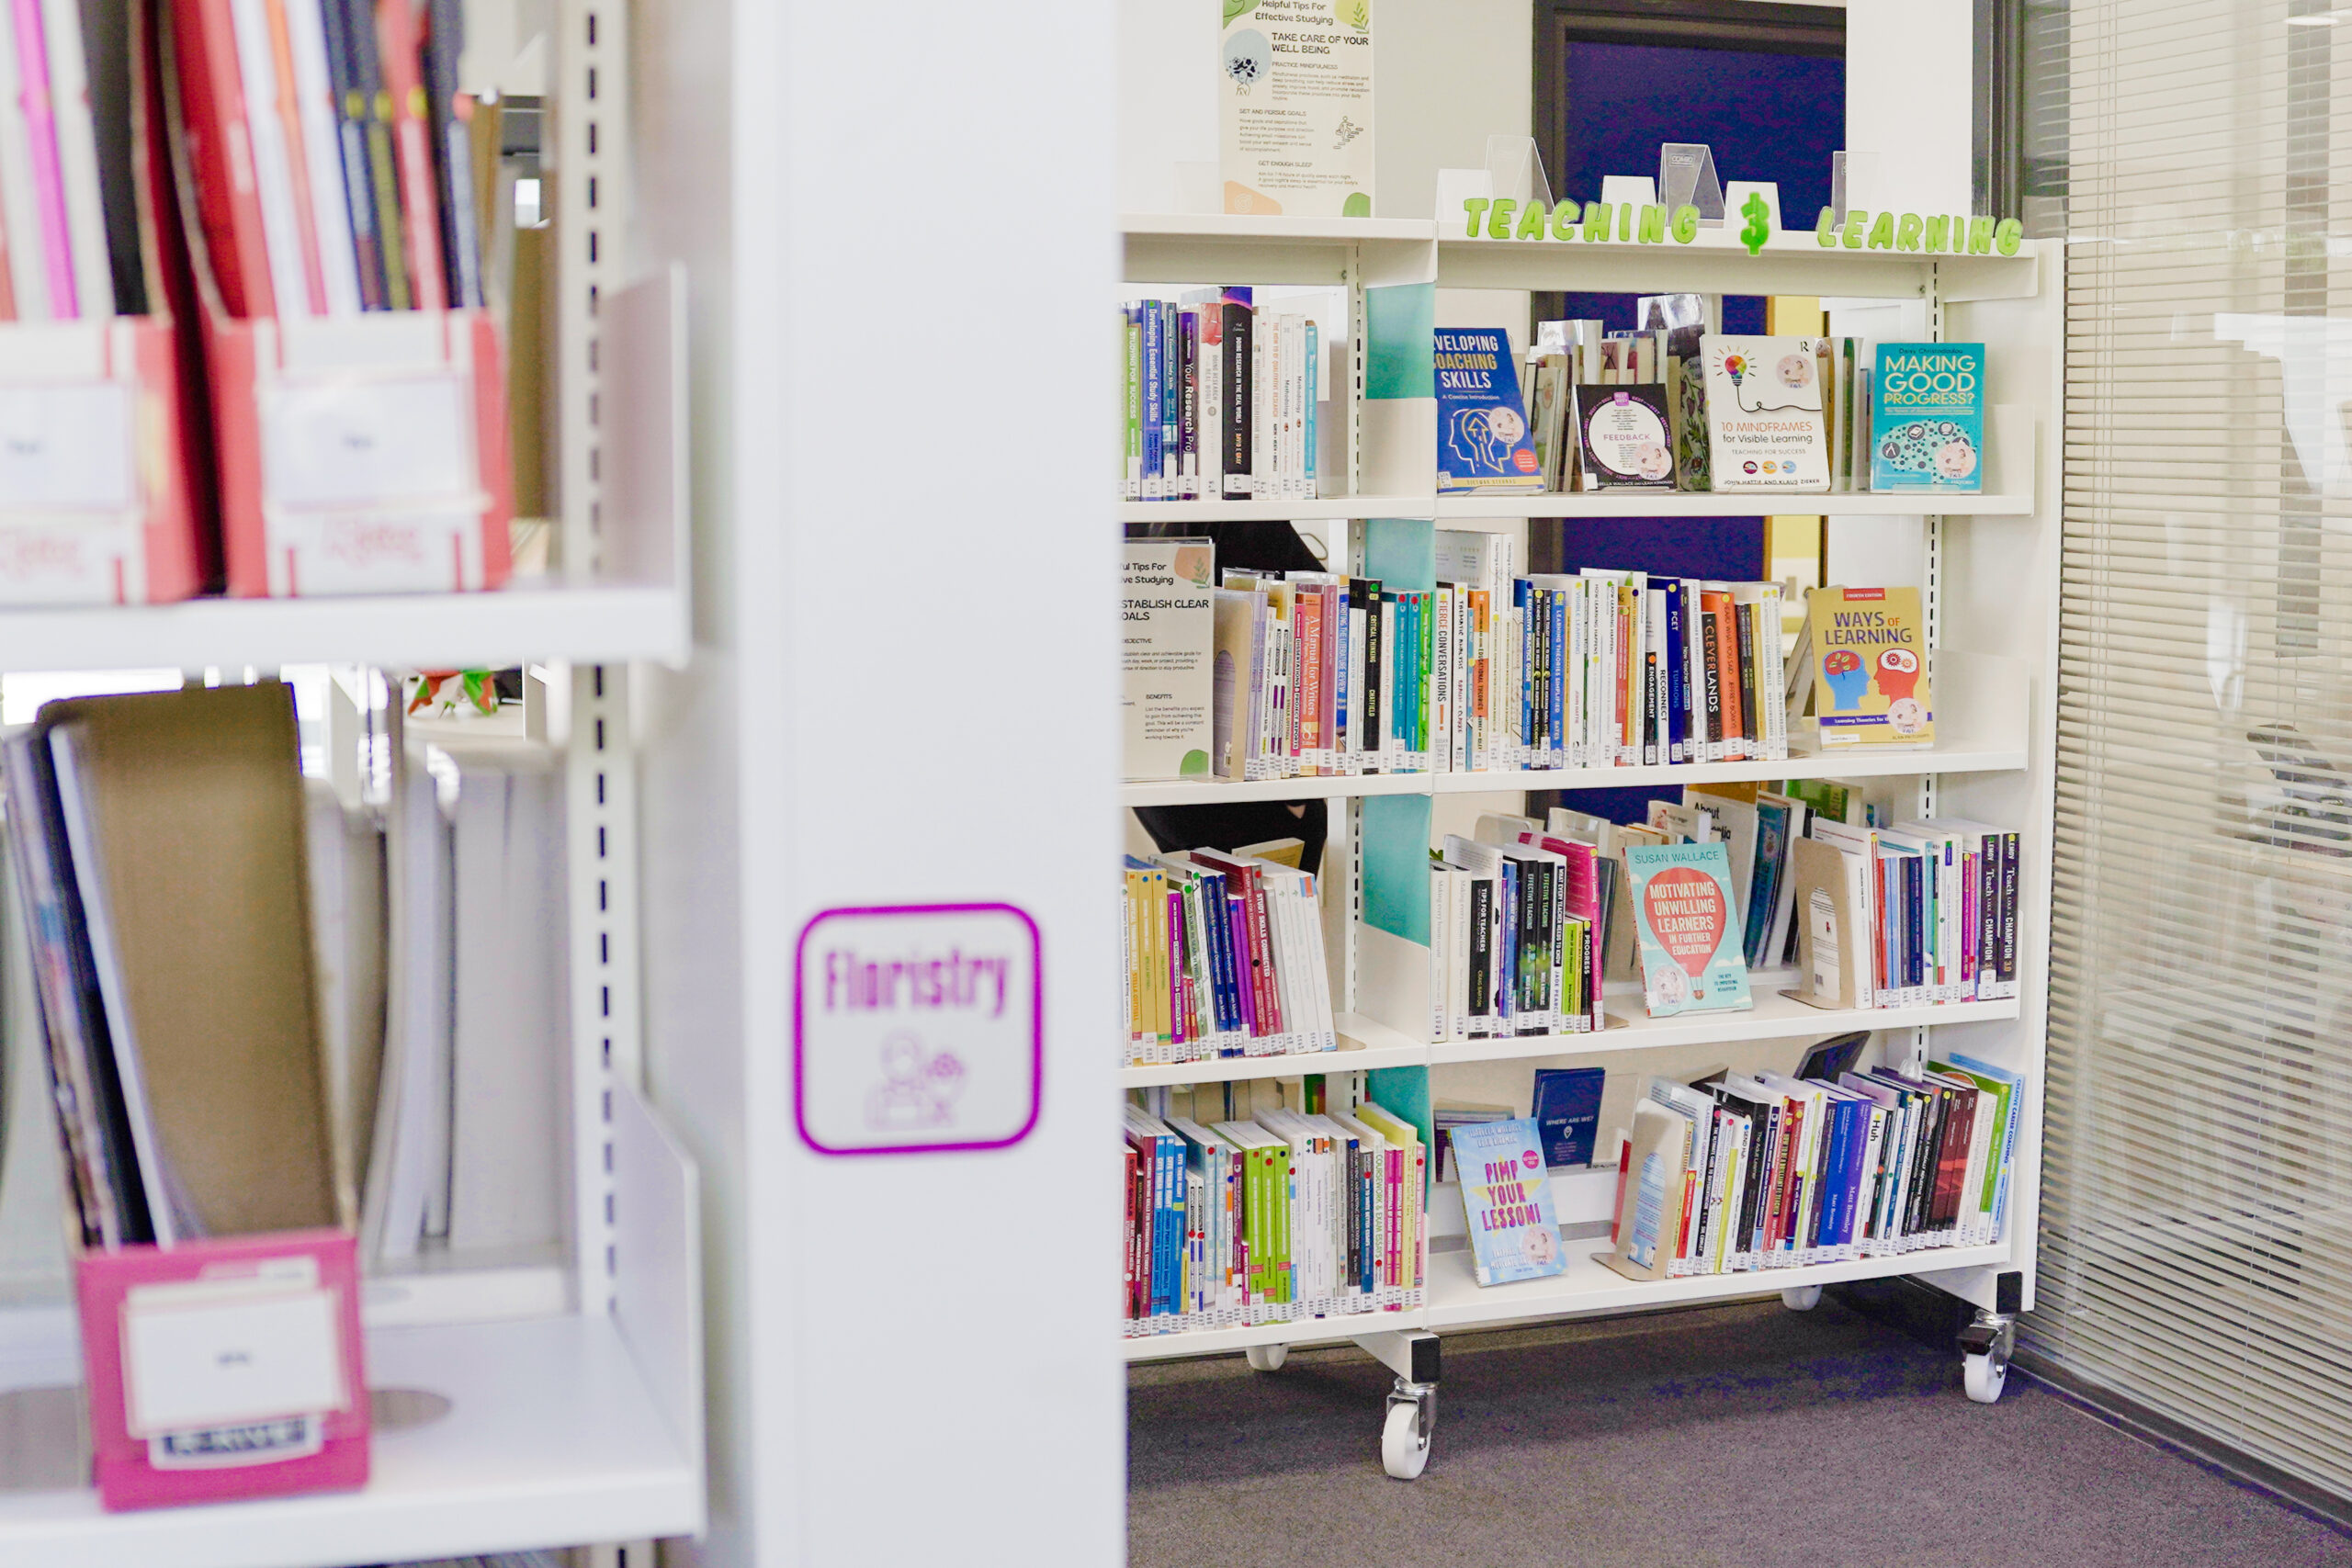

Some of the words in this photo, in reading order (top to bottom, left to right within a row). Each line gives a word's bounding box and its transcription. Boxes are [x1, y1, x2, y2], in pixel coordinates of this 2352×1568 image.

[1261, 0, 1291, 9] Helpful
[1293, 1, 1310, 11] Tips
[1311, 2, 1327, 10] For
[1255, 12, 1295, 22] Effective
[1295, 14, 1334, 26] Studying
[1272, 32, 1298, 42] TAKE
[1300, 34, 1326, 43] CARE
[1328, 35, 1341, 44] OF
[1343, 37, 1369, 45] YOUR
[1272, 43, 1299, 53] WELL
[1301, 45, 1330, 54] BEING
[1464, 197, 1699, 244] TEACHING
[1816, 206, 2024, 257] LEARNING
[1147, 309, 1158, 347] Developing
[1434, 334, 1499, 352] VELOPING
[1800, 341, 1809, 352] R
[1148, 348, 1158, 379] Essential
[1433, 353, 1498, 370] OACHING
[1884, 355, 1976, 372] MAKING
[1441, 371, 1492, 389] SKILLS
[1884, 372, 1975, 392] GOOD
[1148, 381, 1158, 400] Study
[1883, 392, 1975, 405] PROGRESS?
[1148, 401, 1159, 422] Skills
[1721, 422, 1734, 433] 10
[1736, 421, 1813, 433] MINDFRAMES
[1723, 434, 1736, 444] for
[1737, 434, 1769, 444] Visible
[1771, 434, 1814, 445] Learning
[1132, 563, 1149, 572] Tips
[1151, 562, 1167, 570] For
[1135, 576, 1174, 585] Studying
[1120, 599, 1172, 609] STABLISH
[1174, 599, 1209, 609] CLEAR
[1121, 611, 1150, 621] OALS
[1310, 615, 1320, 624] A
[1340, 602, 1348, 626] WRITING
[1438, 600, 1448, 630] FIERCE
[1834, 611, 1884, 627] WAYS
[1887, 617, 1901, 626] OF
[1308, 626, 1320, 665] Manual
[1825, 627, 1913, 646] LEARNING
[1339, 637, 1347, 670] LITERATURE
[1308, 666, 1319, 680] for
[1438, 630, 1448, 702] CONVERSATIONS
[1704, 626, 1719, 713] CLEVERLANDS
[1338, 671, 1346, 694] REVIEW
[1307, 681, 1318, 716] Writers
[1634, 853, 1669, 864] SUSAN
[1672, 851, 1720, 862] WALLACE
[1649, 881, 1716, 899] MOTIVATING
[1256, 893, 1265, 914] STUDY
[1654, 897, 1716, 917] UNWILLING
[1258, 915, 1267, 938] SKILLS
[1657, 915, 1714, 933] LEARNERS
[1668, 934, 1678, 944] IN
[1679, 931, 1712, 943] FURTHER
[1261, 939, 1270, 977] CONNECTED
[1672, 942, 1712, 955] EDUCATION
[825, 949, 1007, 1020] Floristry
[2012, 1078, 2022, 1107] CREATIVE
[1545, 1118, 1568, 1126] WHERE
[2008, 1107, 2018, 1130] CAREER
[1870, 1120, 1881, 1142] Huh
[2004, 1130, 2014, 1164] COACHING
[1485, 1159, 1519, 1184] PIMP
[1487, 1182, 1527, 1207] YOUR
[1847, 1185, 1856, 1203] Matt
[1481, 1202, 1542, 1232] LESSON!
[1827, 1208, 1837, 1230] Bromley
[1842, 1204, 1853, 1234] Bromley
[1374, 1234, 1383, 1258] ESSAYS
